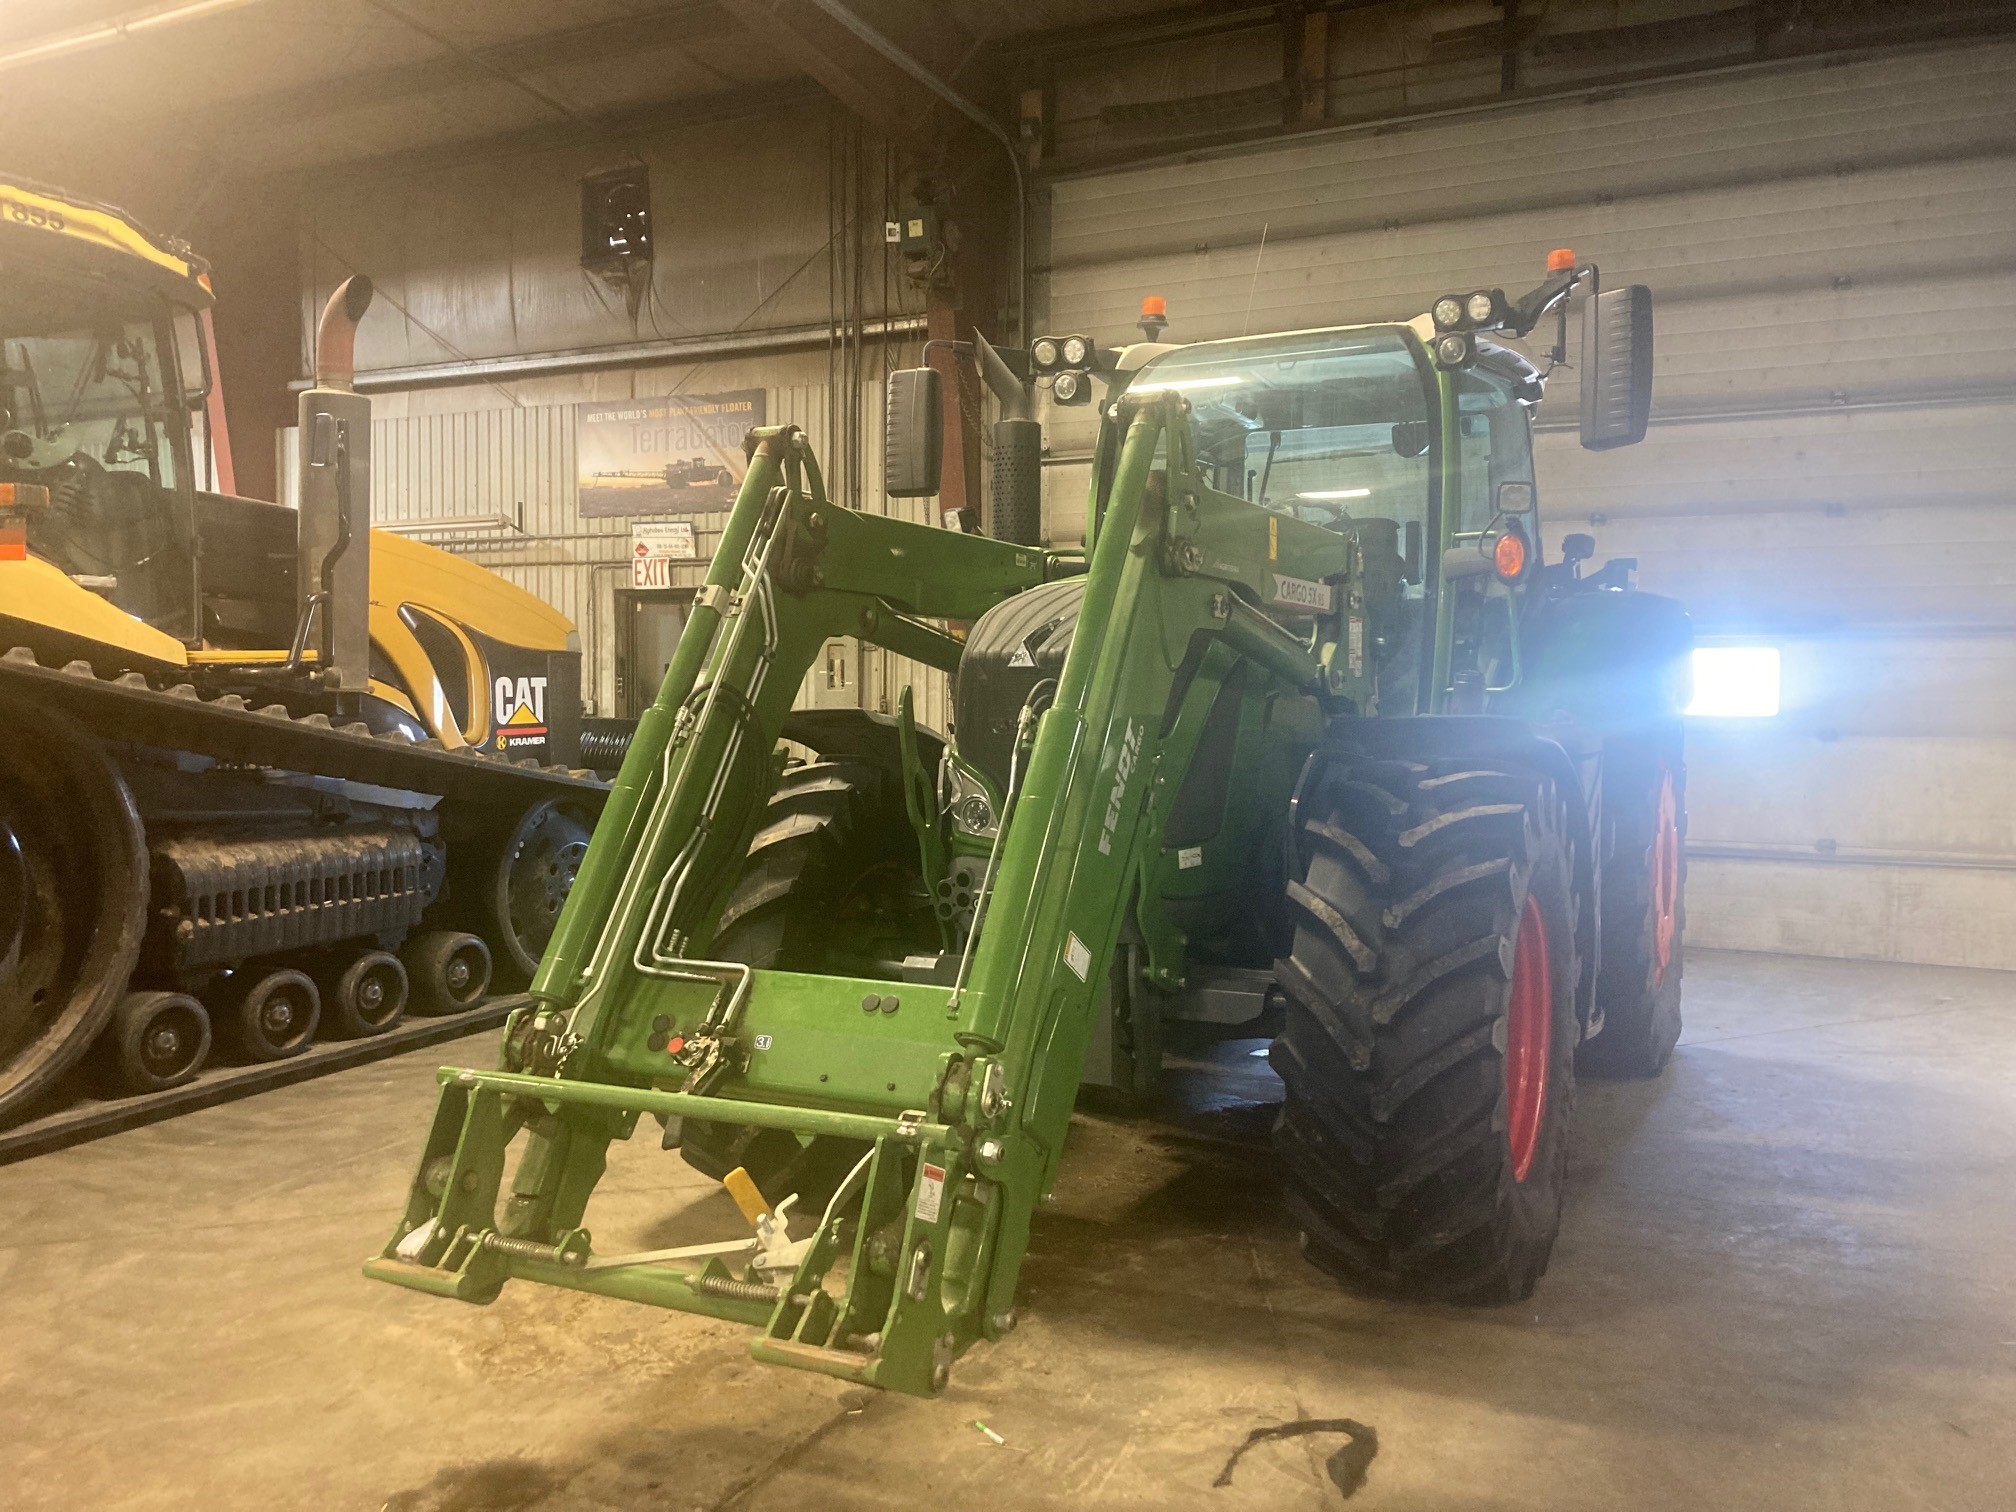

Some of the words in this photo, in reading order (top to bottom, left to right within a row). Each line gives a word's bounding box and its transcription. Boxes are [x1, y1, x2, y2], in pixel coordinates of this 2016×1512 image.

[587, 413, 603, 423] MEET
[605, 411, 617, 422] THE
[617, 409, 648, 421] WORLD'S
[648, 407, 667, 418] MOST
[721, 401, 753, 413] FLOATER
[634, 558, 668, 587] EXIT
[1281, 580, 1307, 603] CARGO
[1308, 587, 1318, 606] 5X
[495, 676, 548, 725] CAT
[509, 736, 546, 747] KRAMER
[1098, 716, 1136, 856] FENDT
